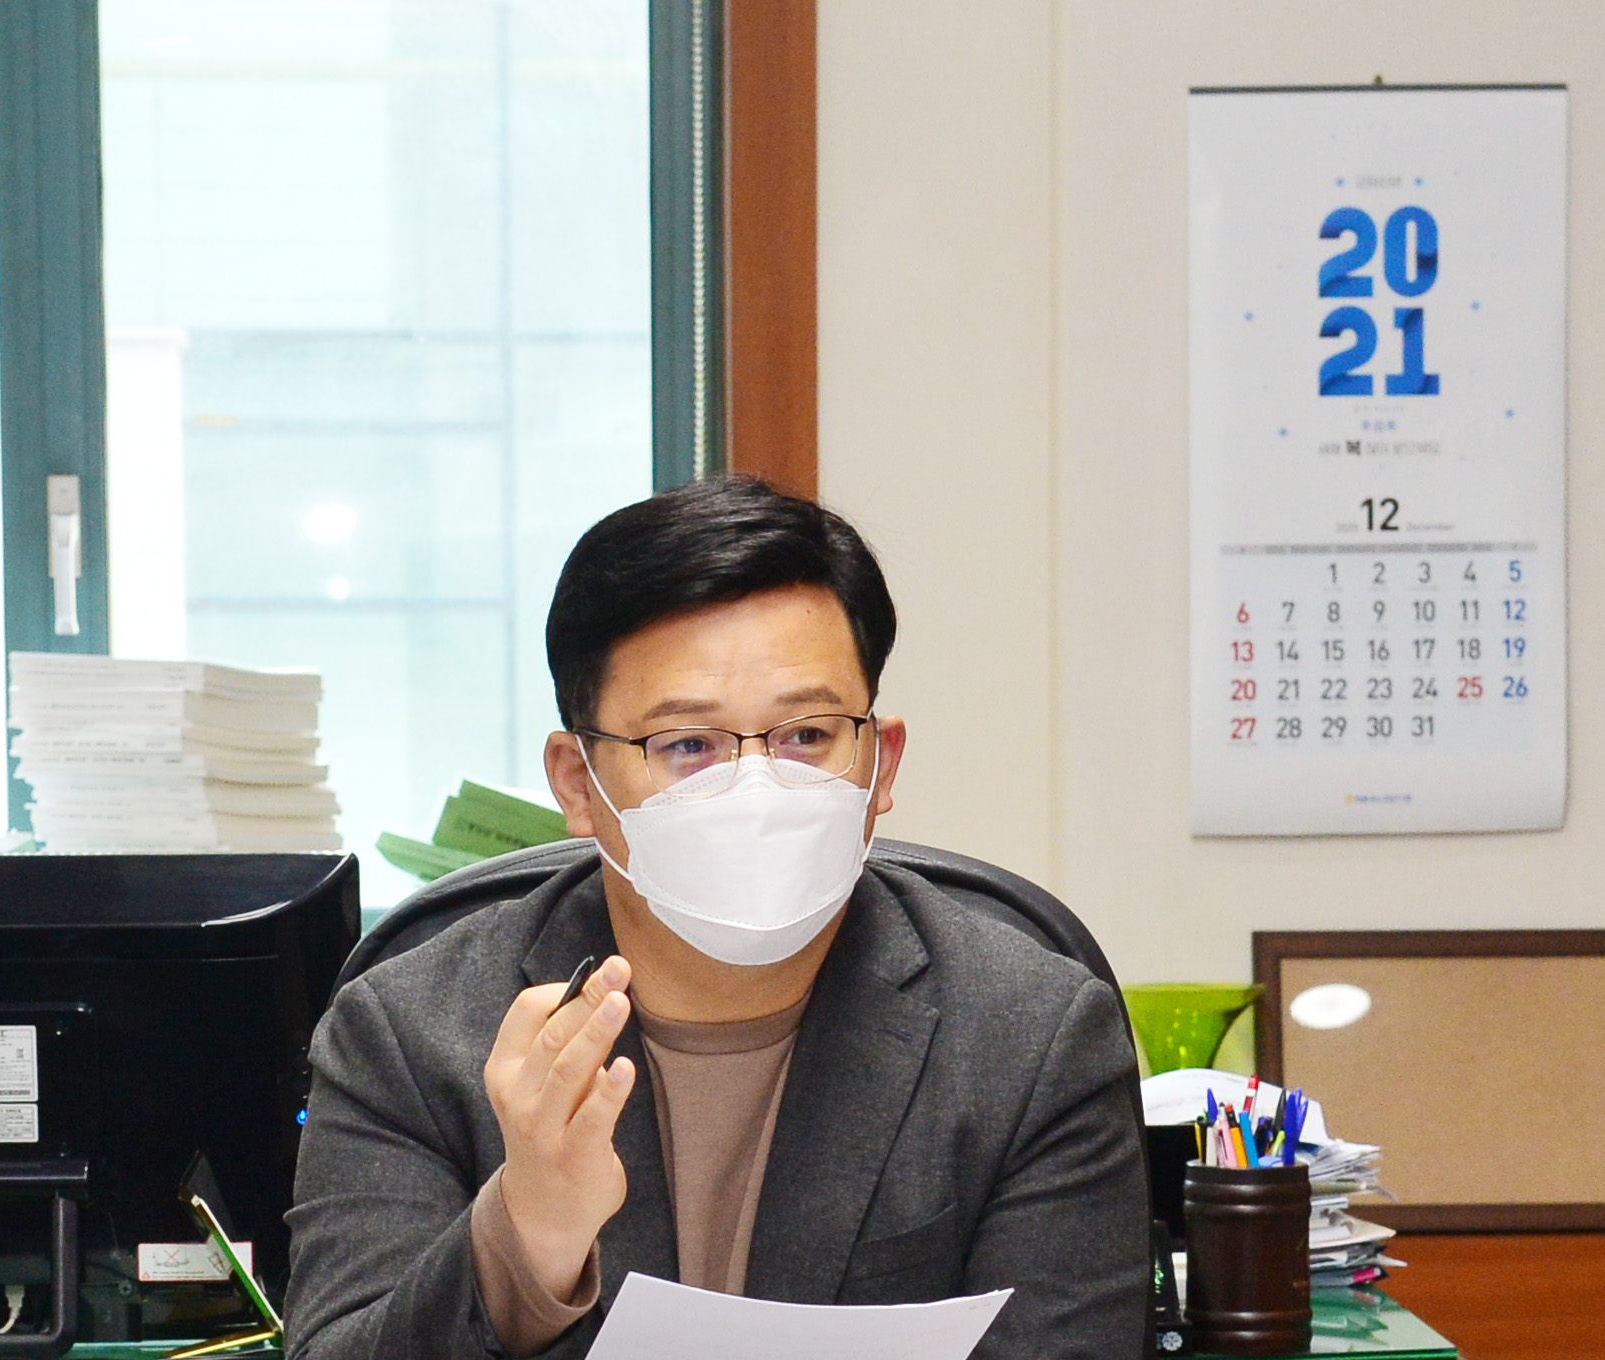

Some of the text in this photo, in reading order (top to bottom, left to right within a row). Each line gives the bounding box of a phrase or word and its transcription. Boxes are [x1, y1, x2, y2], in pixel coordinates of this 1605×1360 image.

[1319, 206, 1439, 298] 20
[1319, 305, 1440, 396] 21
[1360, 496, 1401, 533] 12
[1328, 559, 1522, 586] 1 2 3 4 5
[1236, 599, 1526, 625] 6 7 8 9 10 11 12
[1231, 637, 1526, 663] 13 14 15 16 17 18 19
[1231, 676, 1528, 701] 20 21 22 23 24 25 26
[1231, 715, 1434, 740] 27 28 29 30 31
